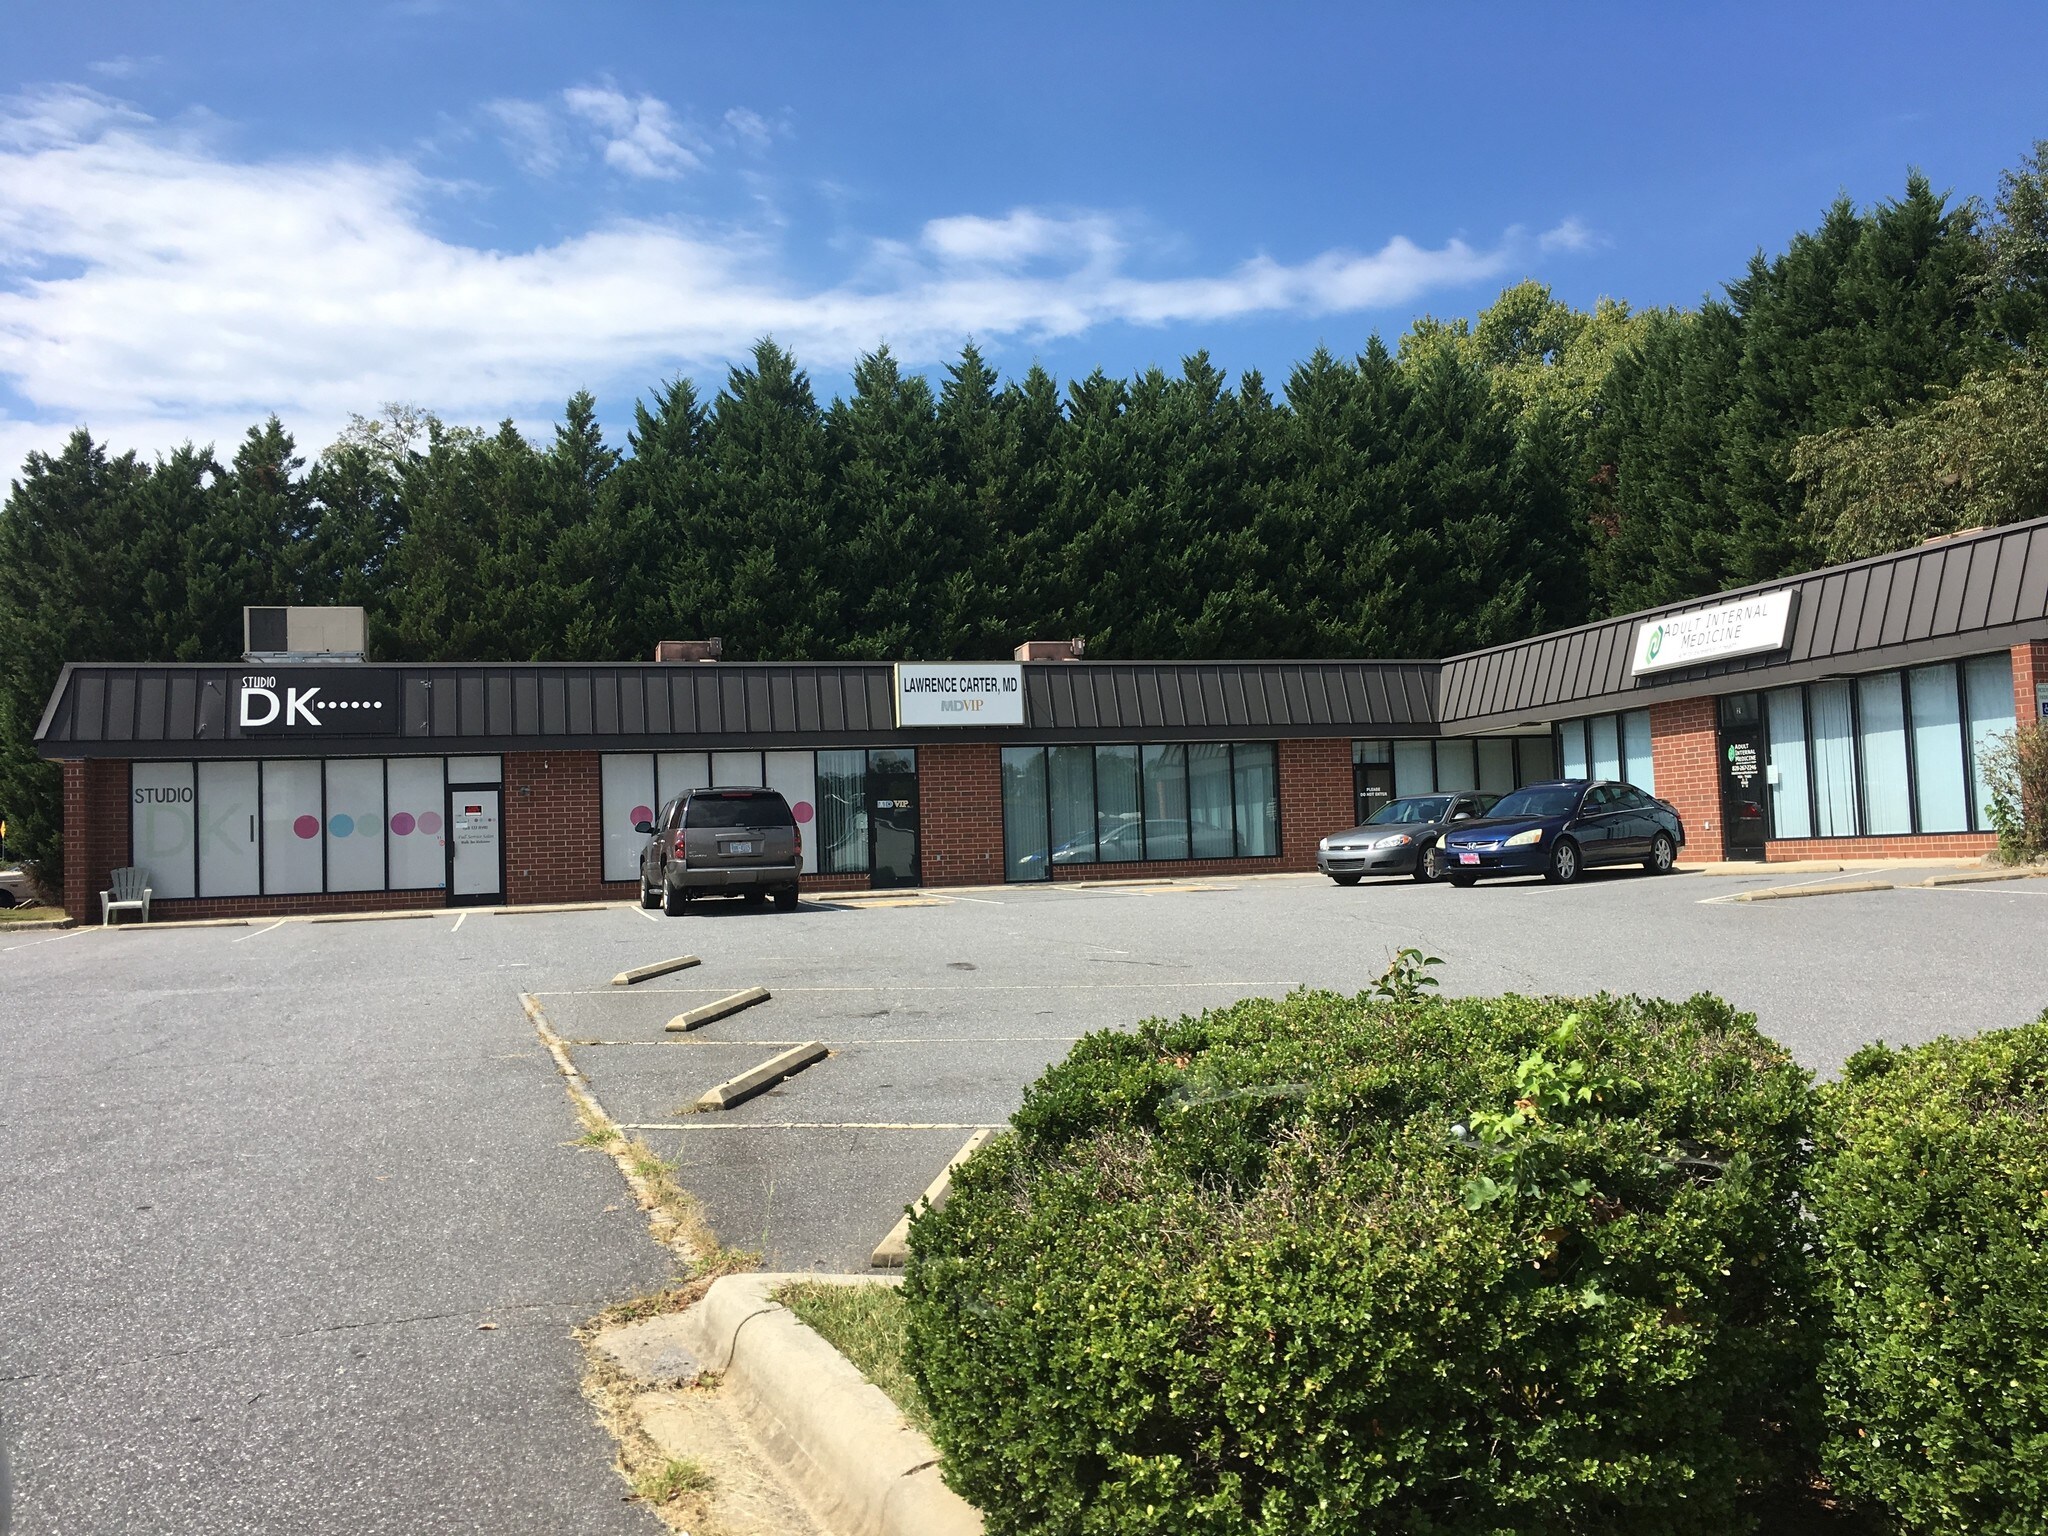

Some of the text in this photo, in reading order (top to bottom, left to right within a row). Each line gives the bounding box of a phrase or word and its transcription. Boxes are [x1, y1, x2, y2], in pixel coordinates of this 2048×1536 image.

[1664, 603, 1768, 637] ADULT INTERNAL
[1681, 625, 1742, 649] MEDICINE
[242, 676, 276, 688] STUDIO
[904, 677, 1018, 695] LAWRENCE CARTER, MD
[134, 787, 193, 804] STUDIO
